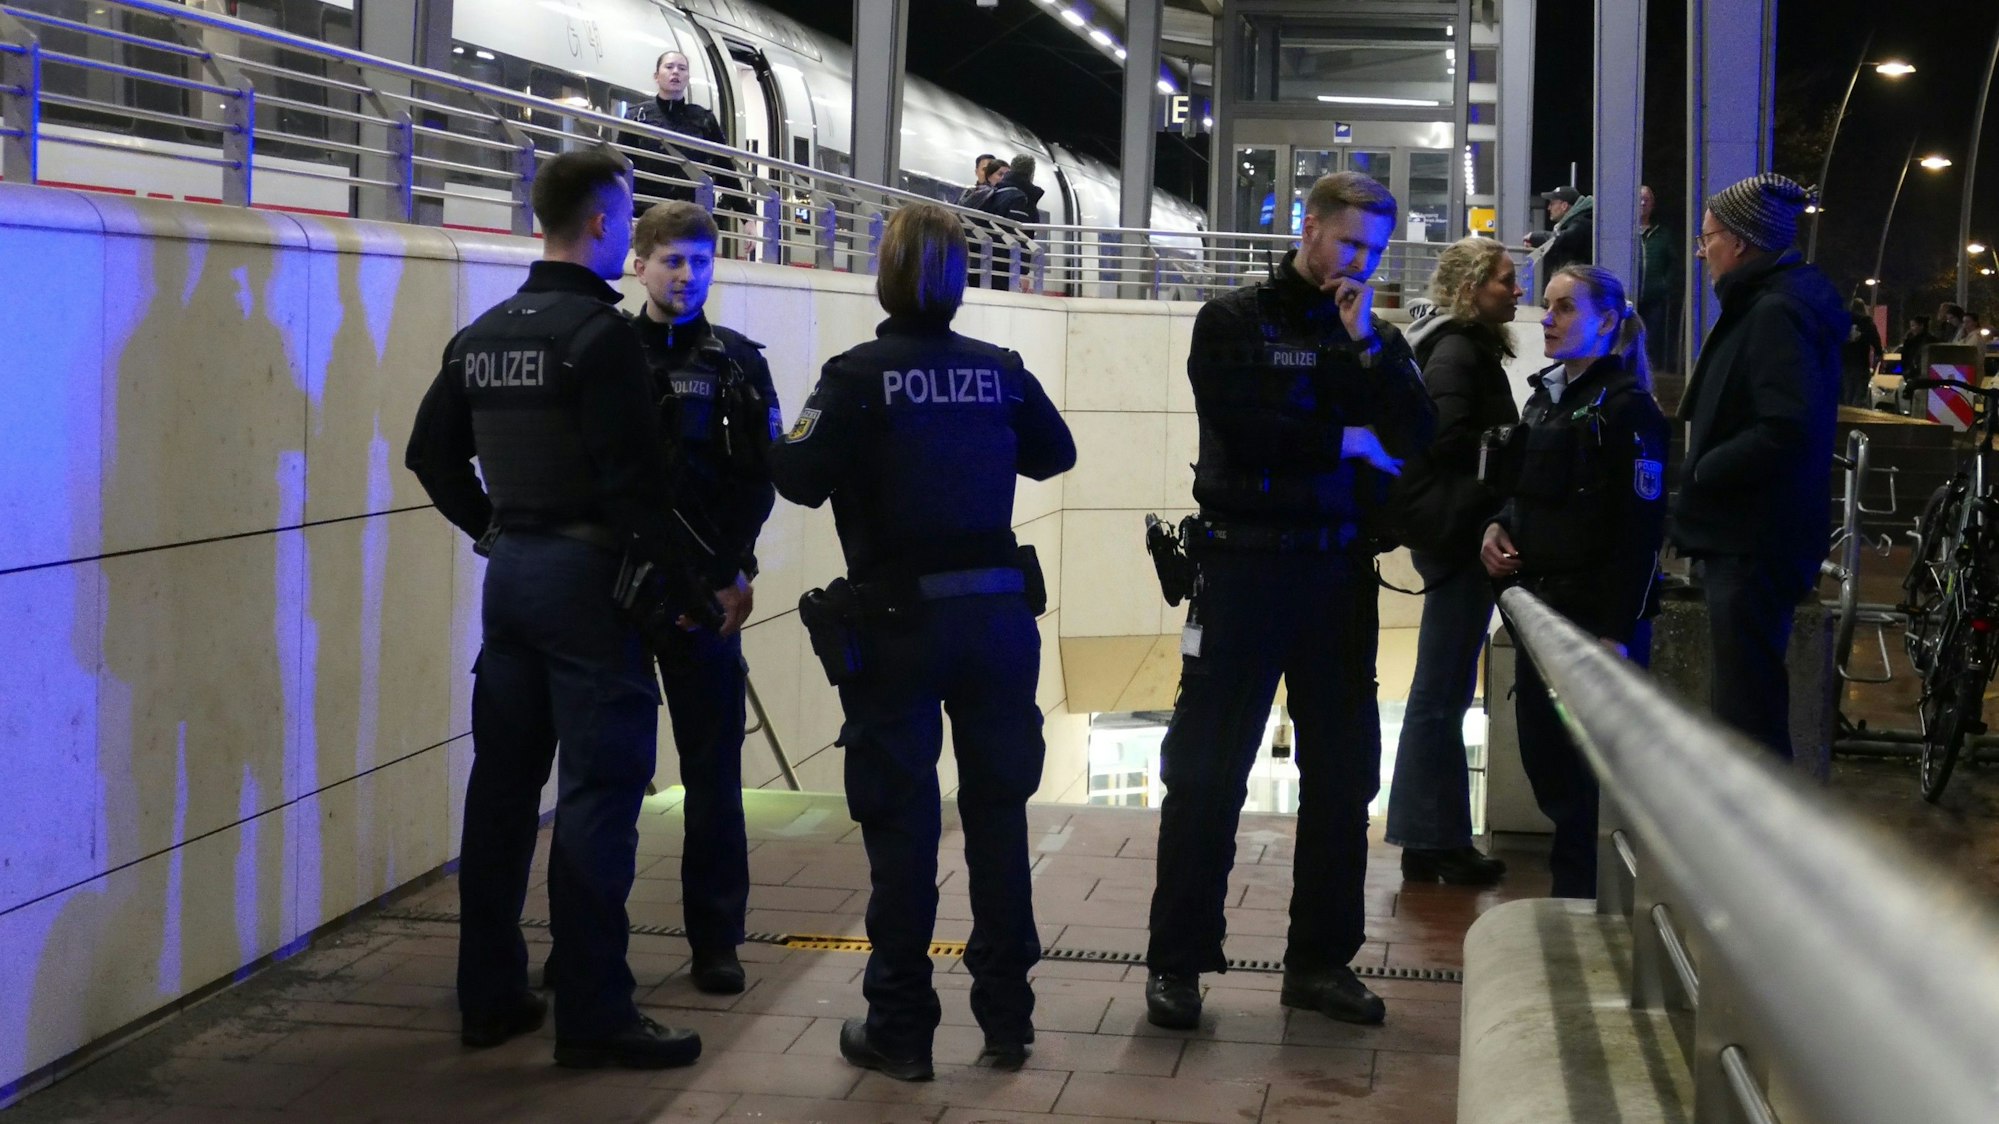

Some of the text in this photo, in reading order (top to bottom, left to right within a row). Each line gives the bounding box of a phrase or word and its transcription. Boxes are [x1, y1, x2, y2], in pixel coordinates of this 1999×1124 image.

[1172, 95, 1189, 124] E
[465, 350, 544, 387] POLIZEI
[1273, 350, 1317, 366] POLIZEI
[883, 368, 1002, 405] POLIZEI
